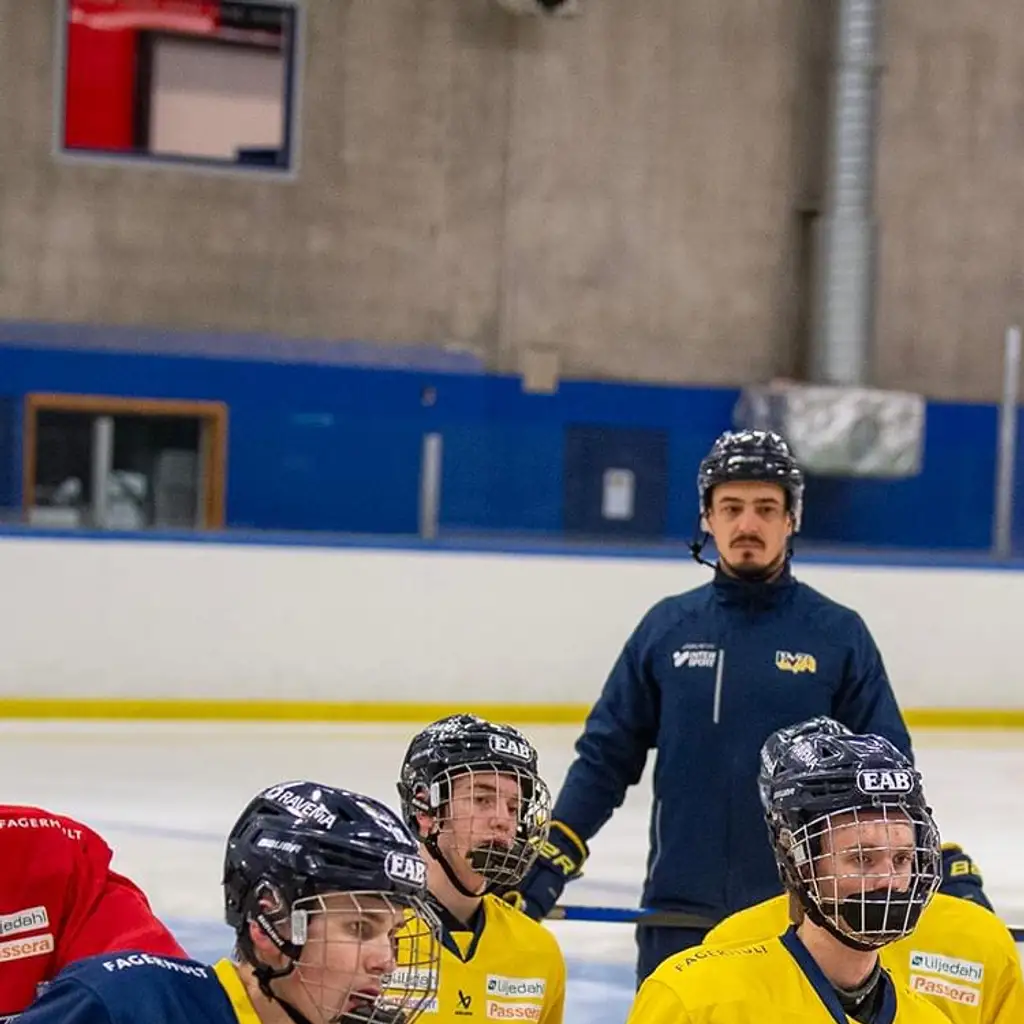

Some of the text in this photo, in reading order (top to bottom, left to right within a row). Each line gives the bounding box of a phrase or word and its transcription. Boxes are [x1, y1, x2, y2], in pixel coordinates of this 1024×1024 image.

[495, 735, 531, 759] EAB
[863, 771, 912, 791] EAB
[277, 790, 337, 830] RAVEMA
[389, 856, 425, 883] EAB
[0, 937, 51, 961] ssera
[923, 956, 983, 980] Liljedahl
[913, 976, 975, 1004] Passera
